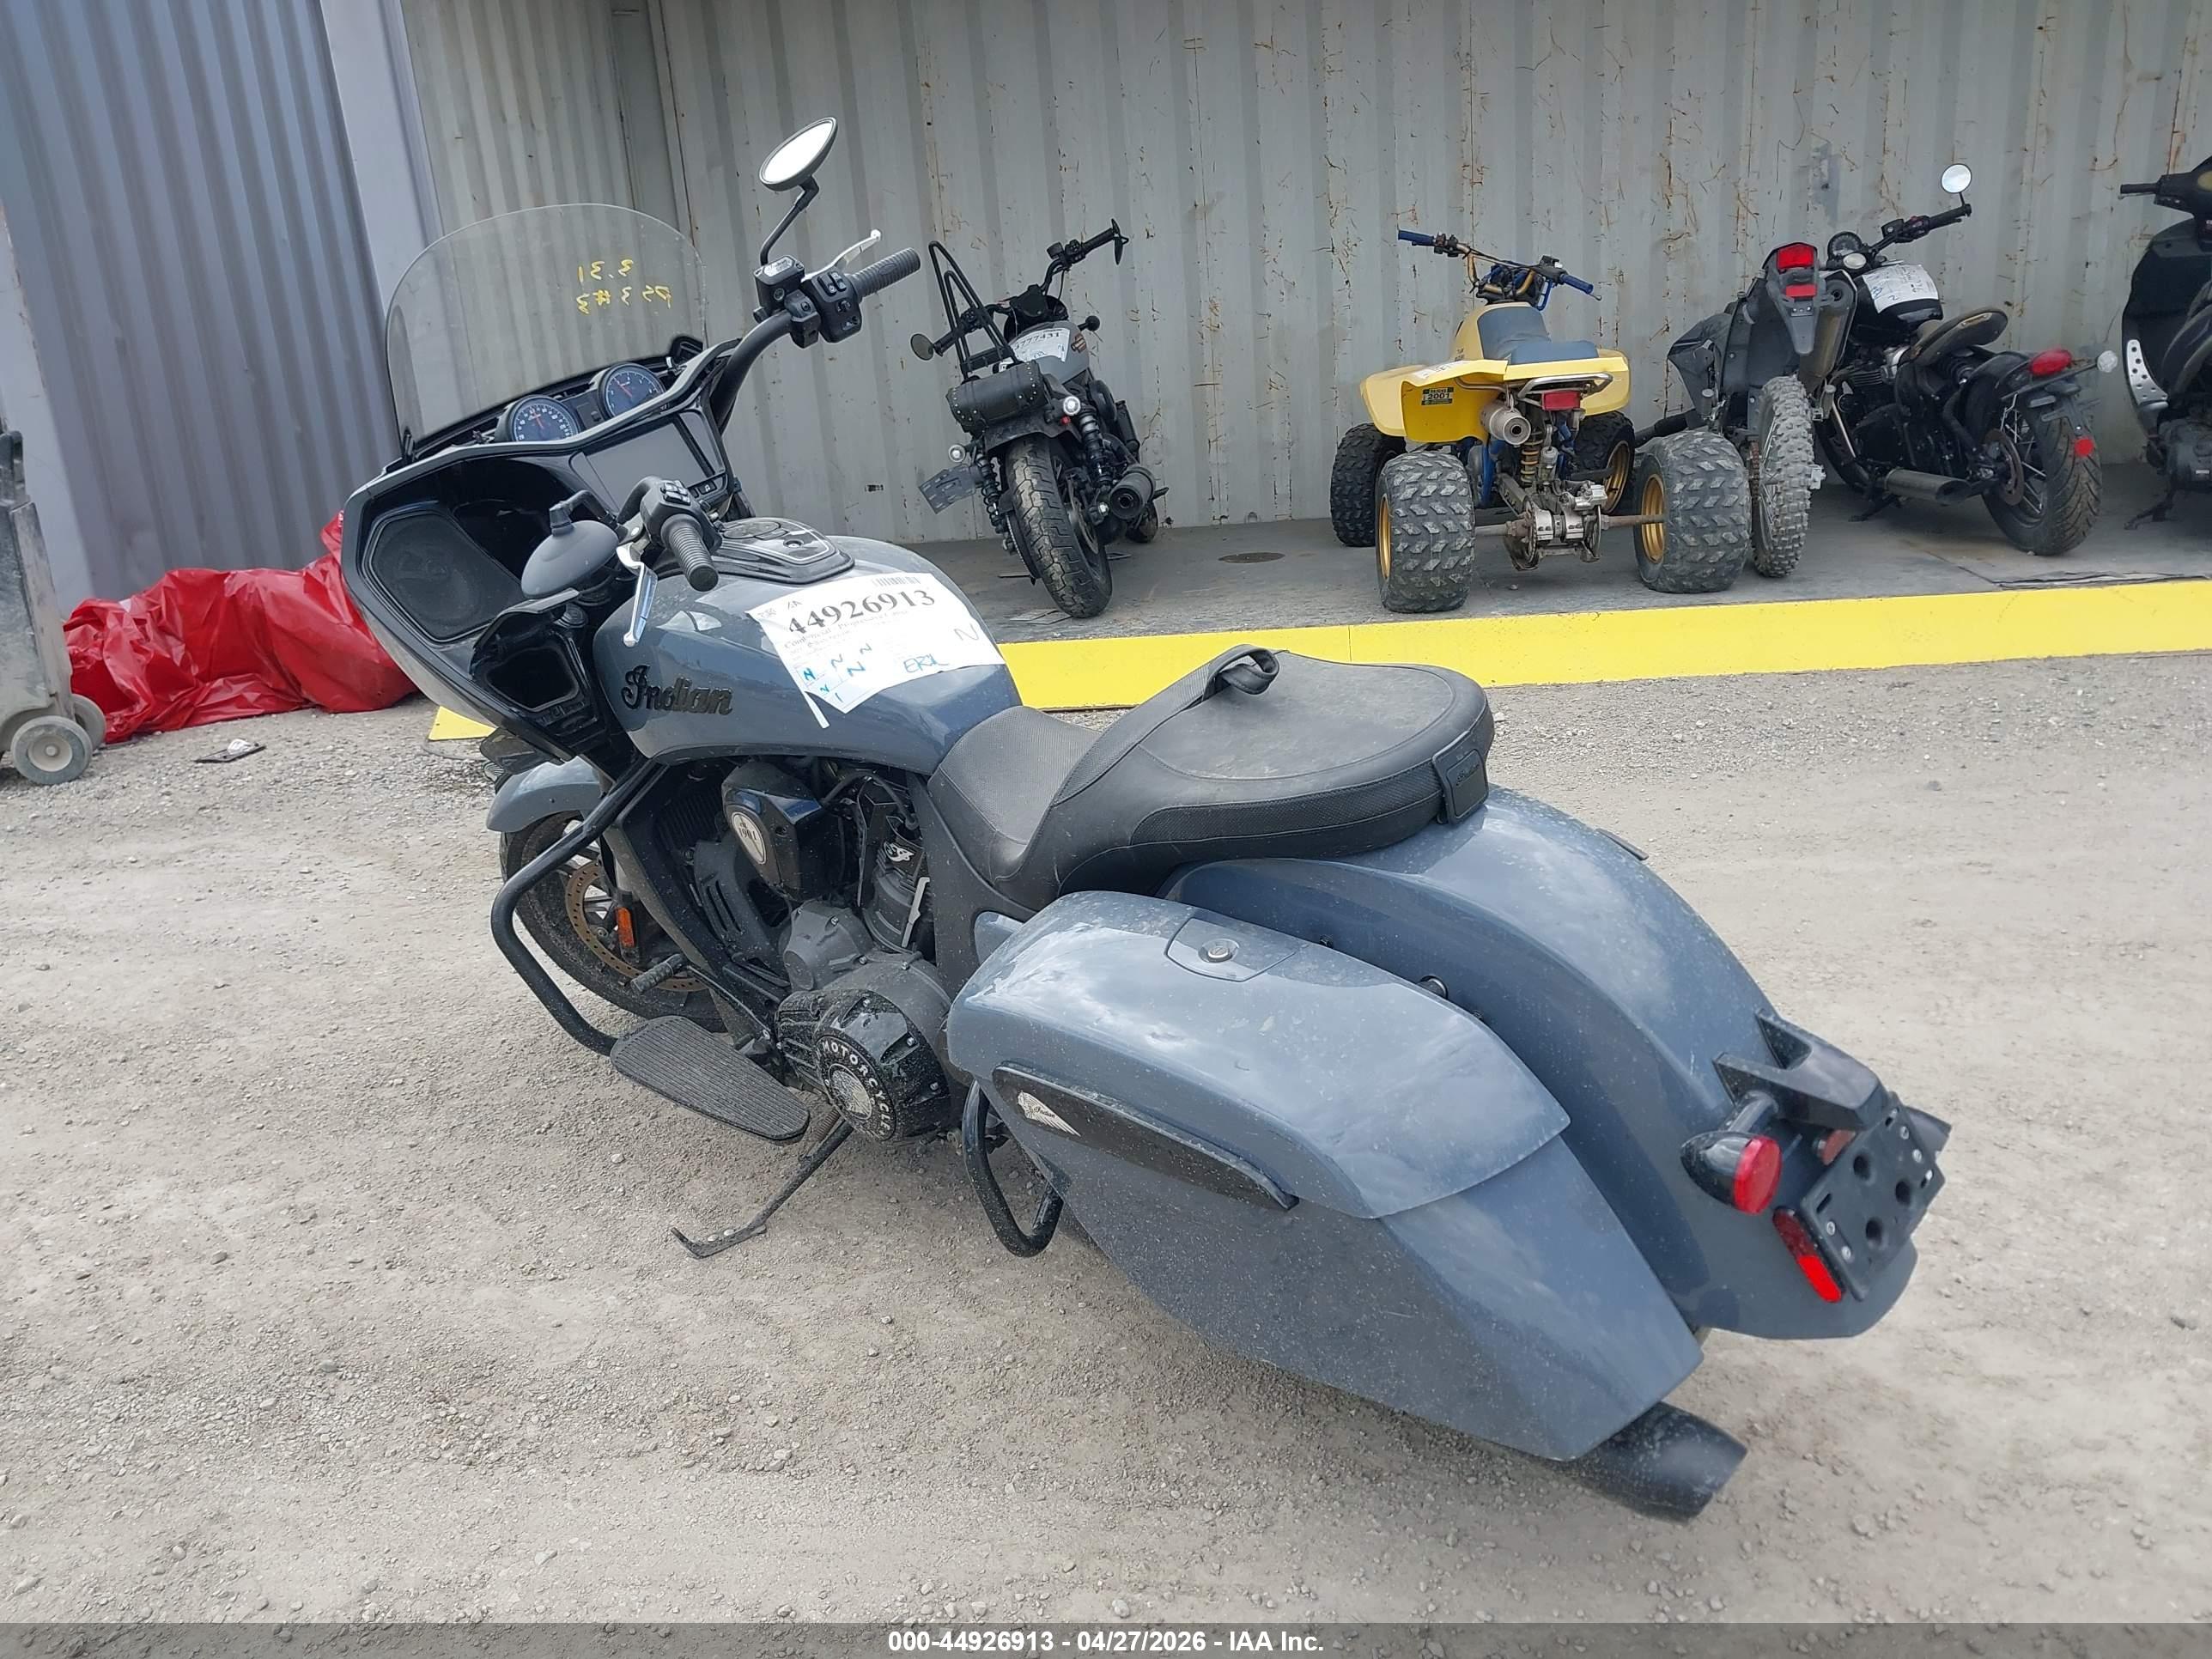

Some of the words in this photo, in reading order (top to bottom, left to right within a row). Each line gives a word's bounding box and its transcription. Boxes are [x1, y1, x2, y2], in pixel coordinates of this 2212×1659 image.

[788, 590, 935, 635] 44926913
[621, 664, 733, 716] Indian
[821, 1040, 891, 1132] MOTORCYCLE
